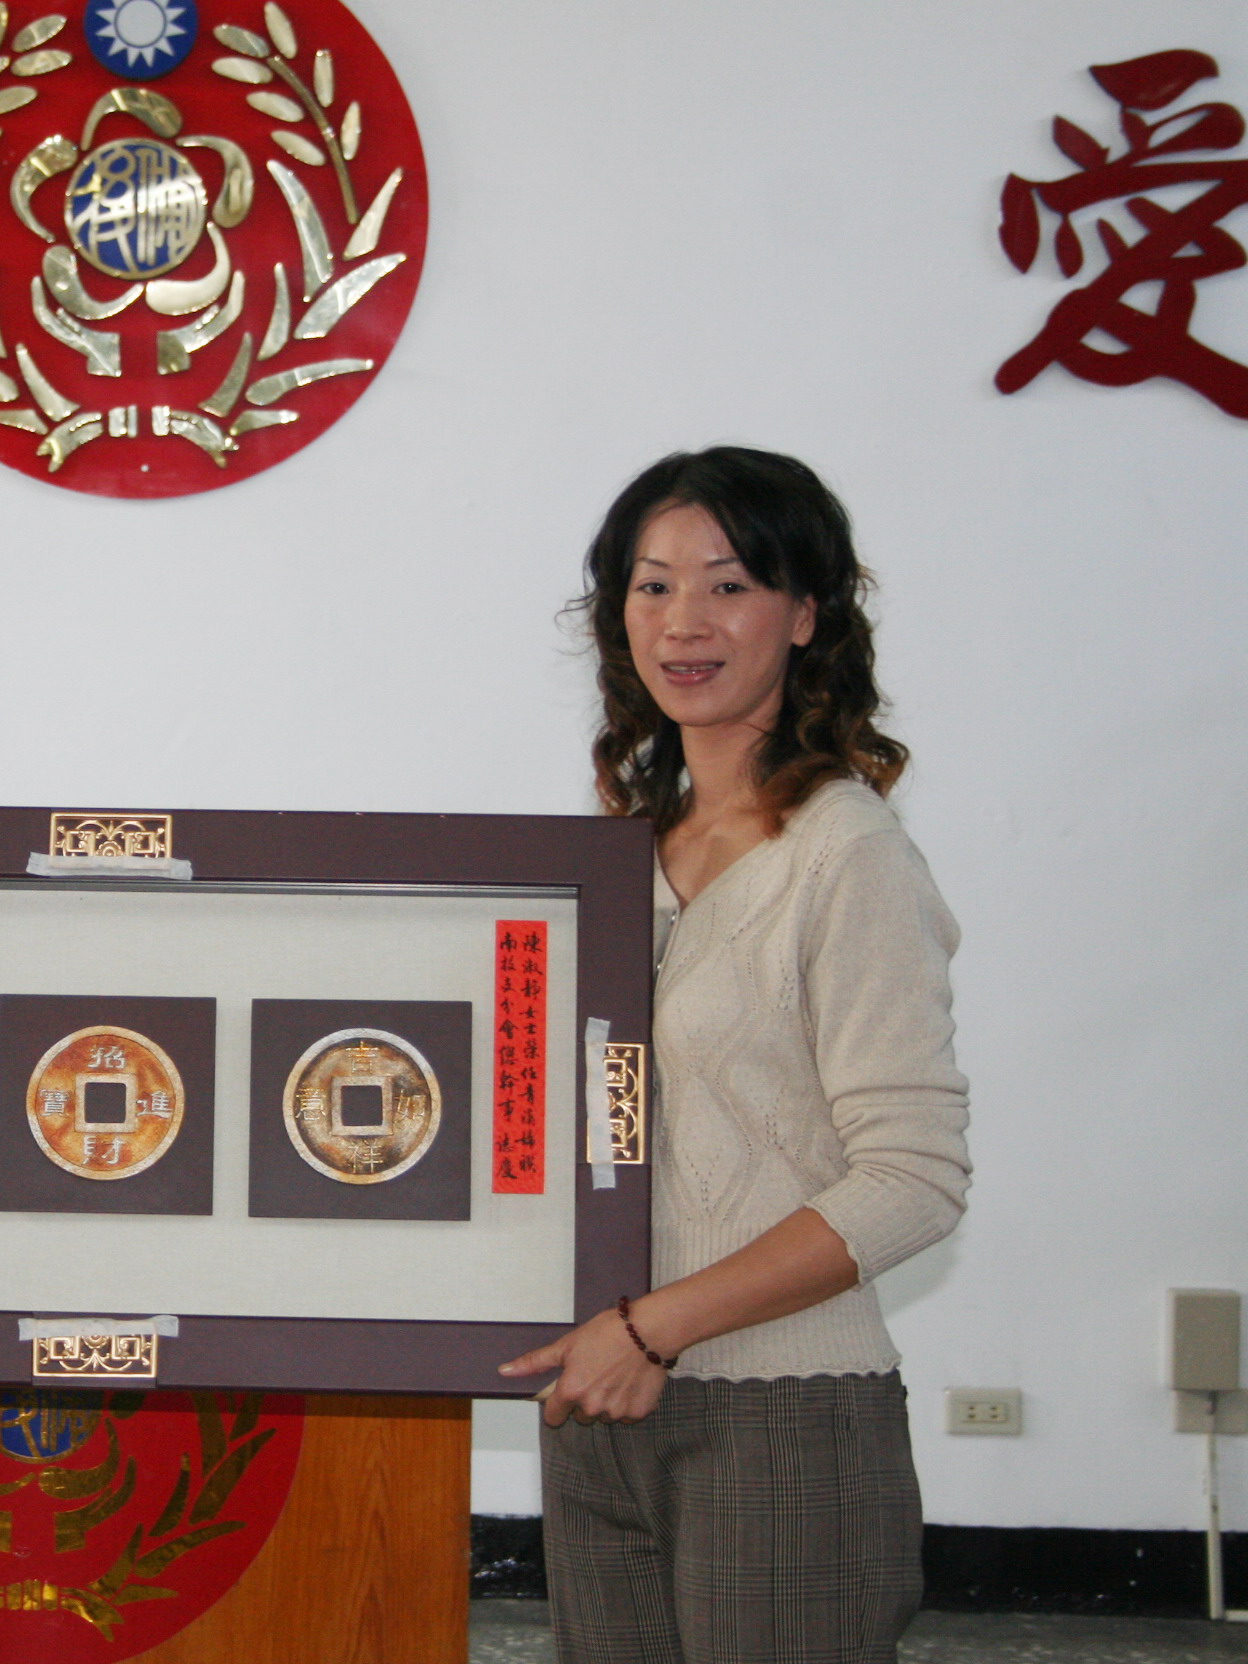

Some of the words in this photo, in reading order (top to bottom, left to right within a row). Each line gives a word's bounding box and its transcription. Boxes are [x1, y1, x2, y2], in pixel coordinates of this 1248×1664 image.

[994, 49, 1248, 420] 愛
[87, 1045, 127, 1070] 招
[345, 1040, 379, 1074] 吉
[39, 1089, 72, 1118] 寶
[136, 1090, 174, 1119] 進
[81, 1135, 126, 1165] 財
[348, 1139, 383, 1174] 祥
